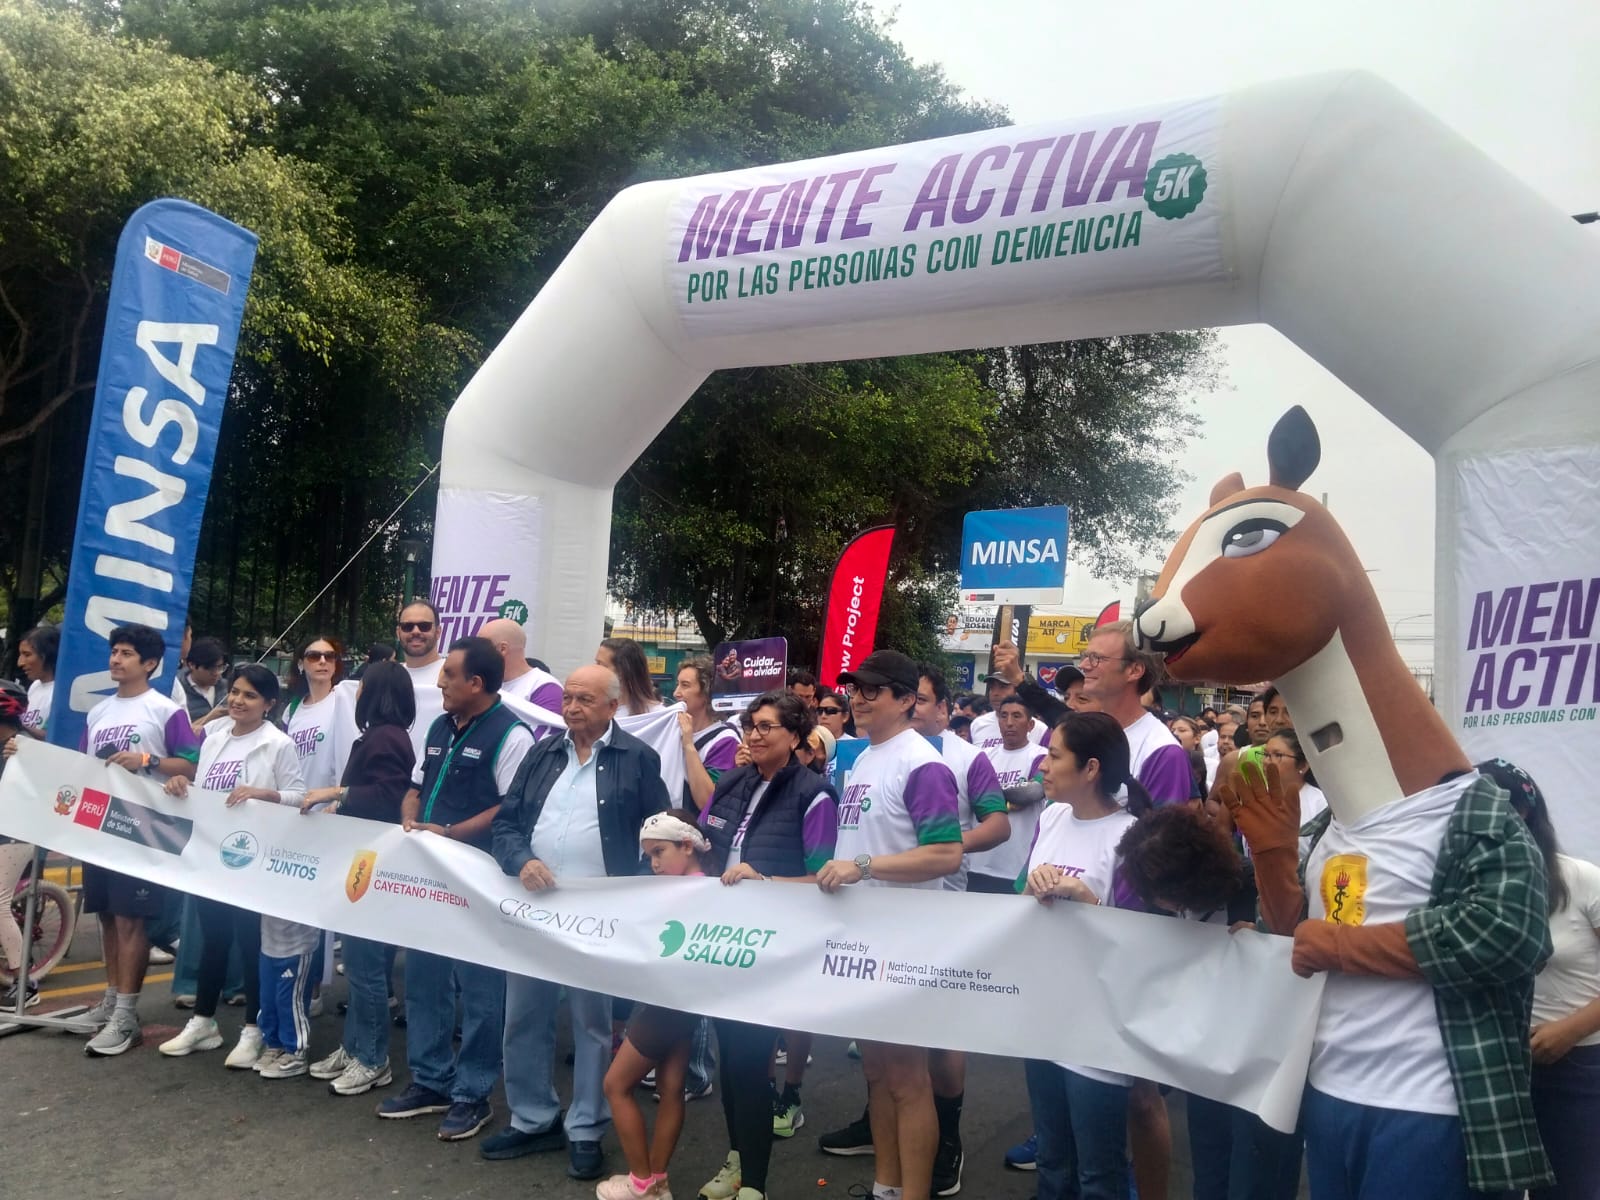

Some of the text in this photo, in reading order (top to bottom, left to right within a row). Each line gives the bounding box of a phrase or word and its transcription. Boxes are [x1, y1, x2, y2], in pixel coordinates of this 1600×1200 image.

[677, 121, 1161, 263] MENTE ACTIVA
[1153, 165, 1198, 202] 5K
[687, 210, 1143, 303] POR LAS PERSONAS CON DEMENCIA
[971, 538, 1060, 566] MINSA
[842, 575, 865, 648] Project
[1039, 620, 1070, 628] MARCA
[743, 655, 775, 668] Cuidar
[743, 666, 782, 677] NO olvidar
[1463, 707, 1597, 728] POR LAS PERSONAS CON
[81, 800, 105, 817] PERÚ
[110, 809, 141, 827] Ministerio
[106, 819, 132, 834] de Salud
[270, 846, 320, 865] Lo hacemos
[266, 858, 318, 881] JUNTOS
[376, 869, 418, 884] UNIVERSIDAD
[374, 879, 470, 909] CAYETANO HEREDIA
[690, 922, 777, 949] IMPACT
[683, 943, 756, 969] SALUD
[825, 939, 870, 955] Funded by
[822, 953, 877, 981] NIHR
[888, 961, 992, 980] National Institute for
[886, 973, 1020, 995] Health and Care Research
